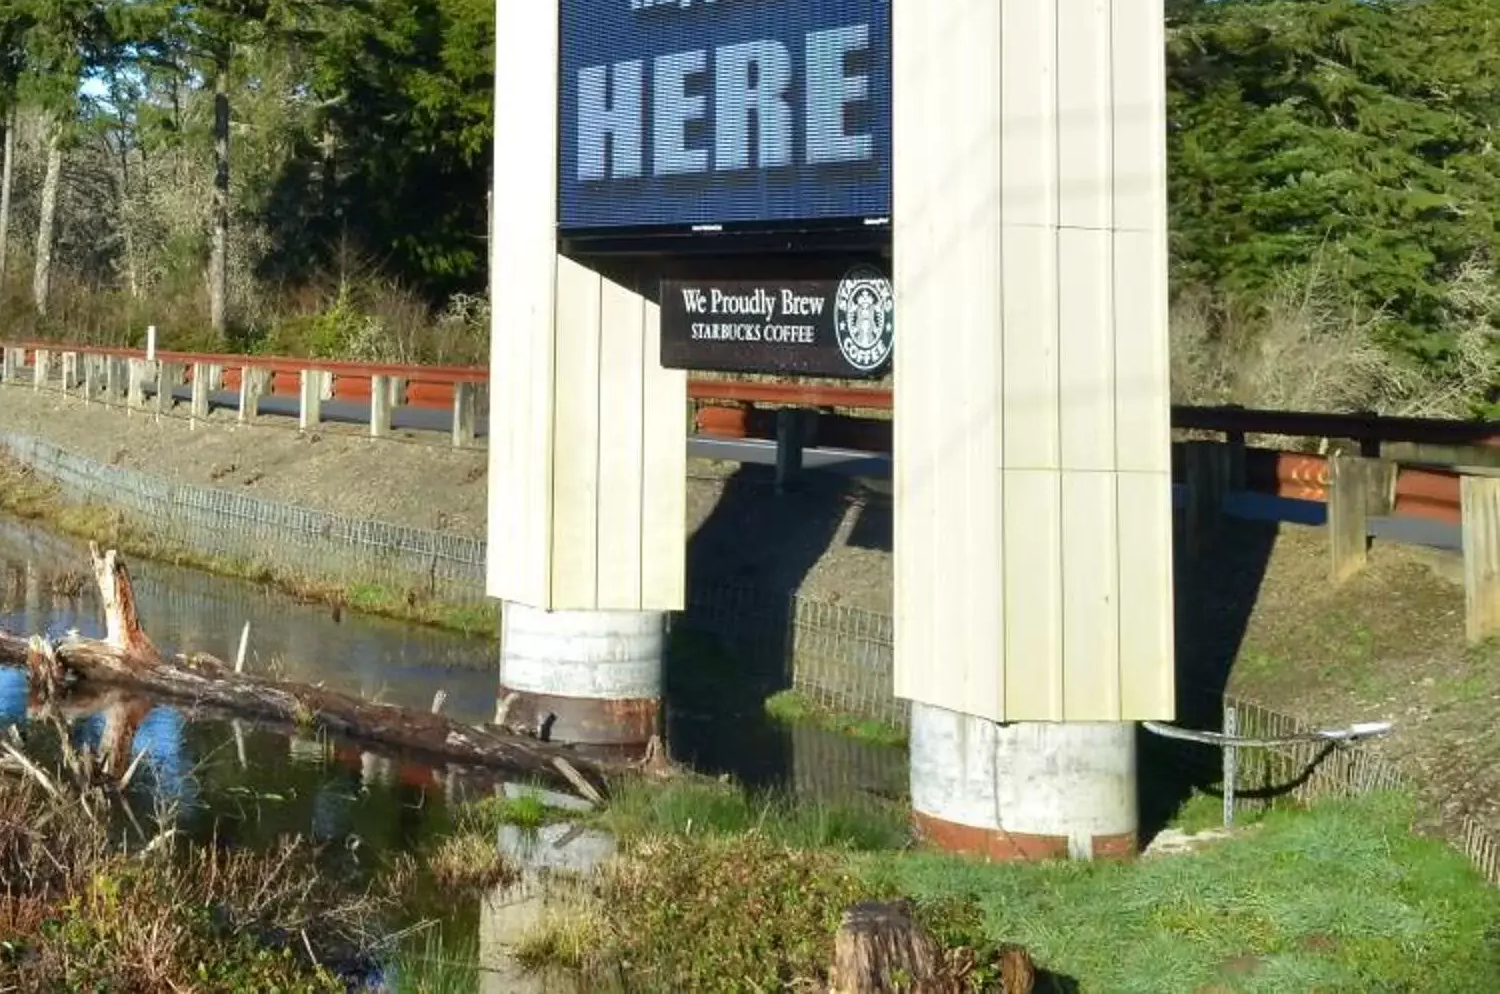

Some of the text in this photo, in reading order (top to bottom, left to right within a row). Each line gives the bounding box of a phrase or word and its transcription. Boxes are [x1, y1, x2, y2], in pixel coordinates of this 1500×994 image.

[577, 23, 874, 181] HERE
[681, 287, 825, 322] We Proudly Brew
[691, 322, 815, 343] STARBUCKS COFFEE
